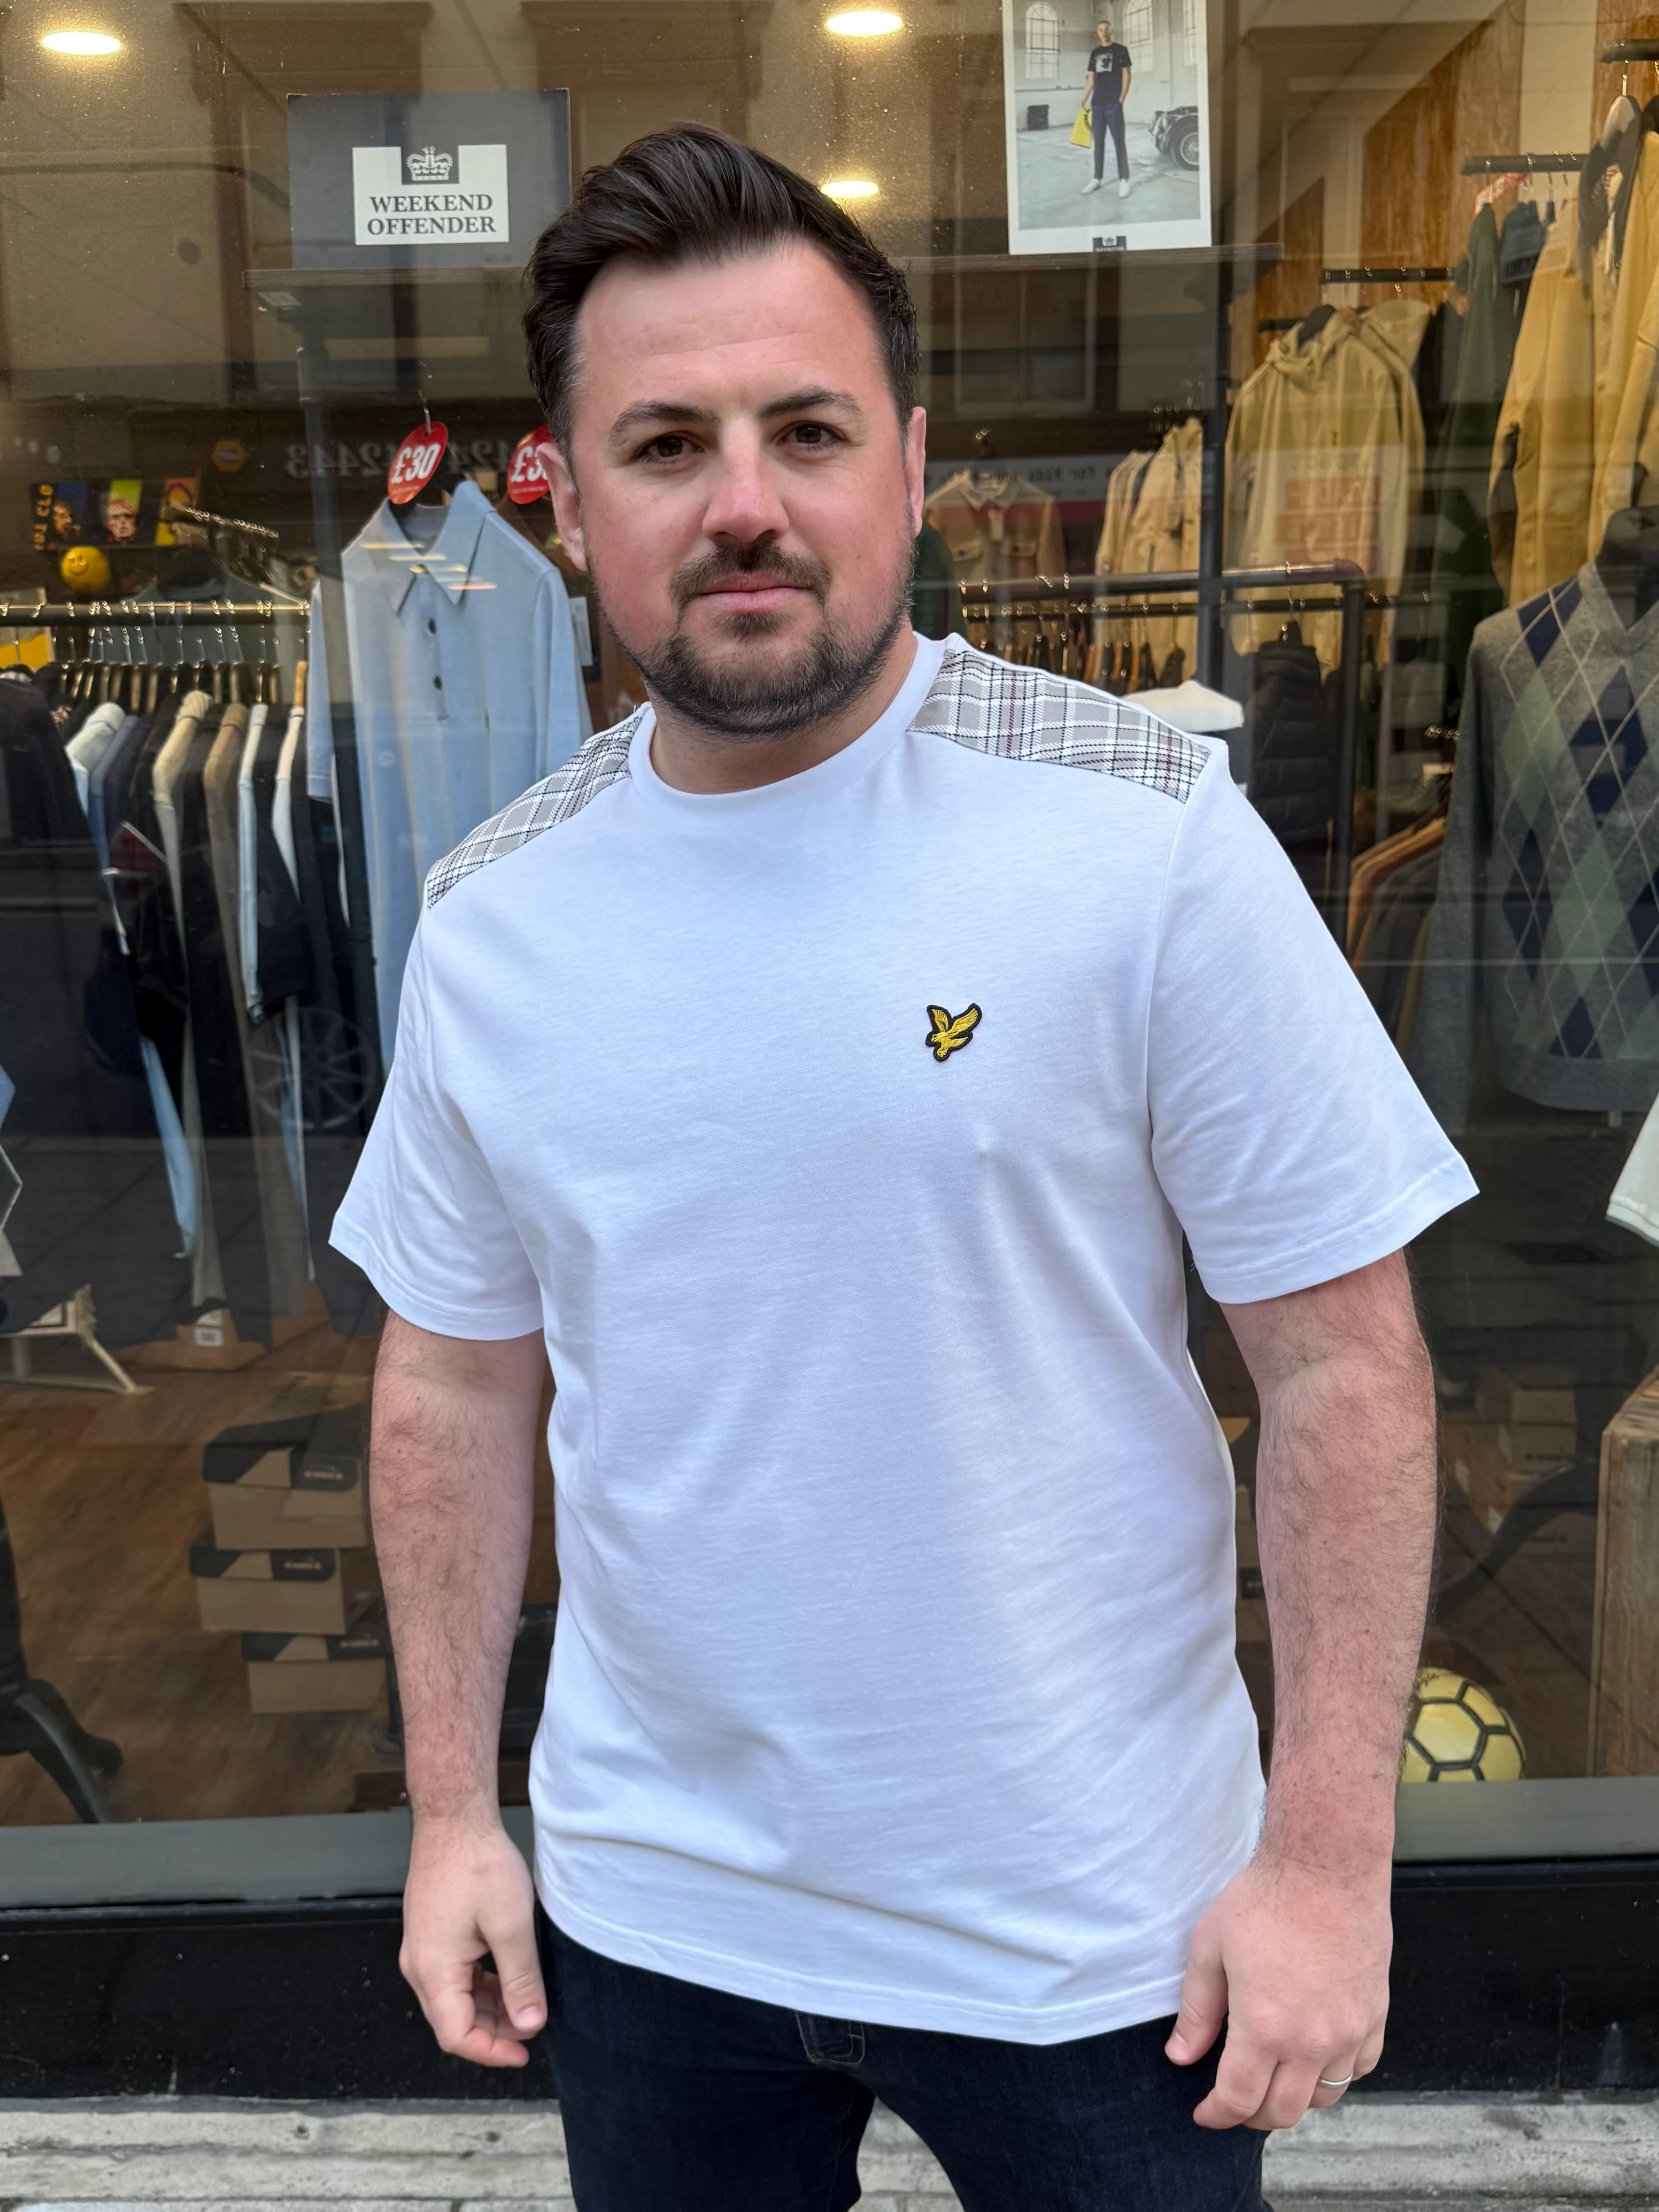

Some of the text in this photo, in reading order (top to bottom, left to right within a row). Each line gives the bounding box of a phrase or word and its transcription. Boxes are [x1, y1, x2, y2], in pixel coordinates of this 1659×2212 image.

[369, 194, 493, 213] WEEKEND
[367, 216, 497, 235] OFFENDER
[390, 443, 442, 484] £30
[510, 445, 549, 484] £3
